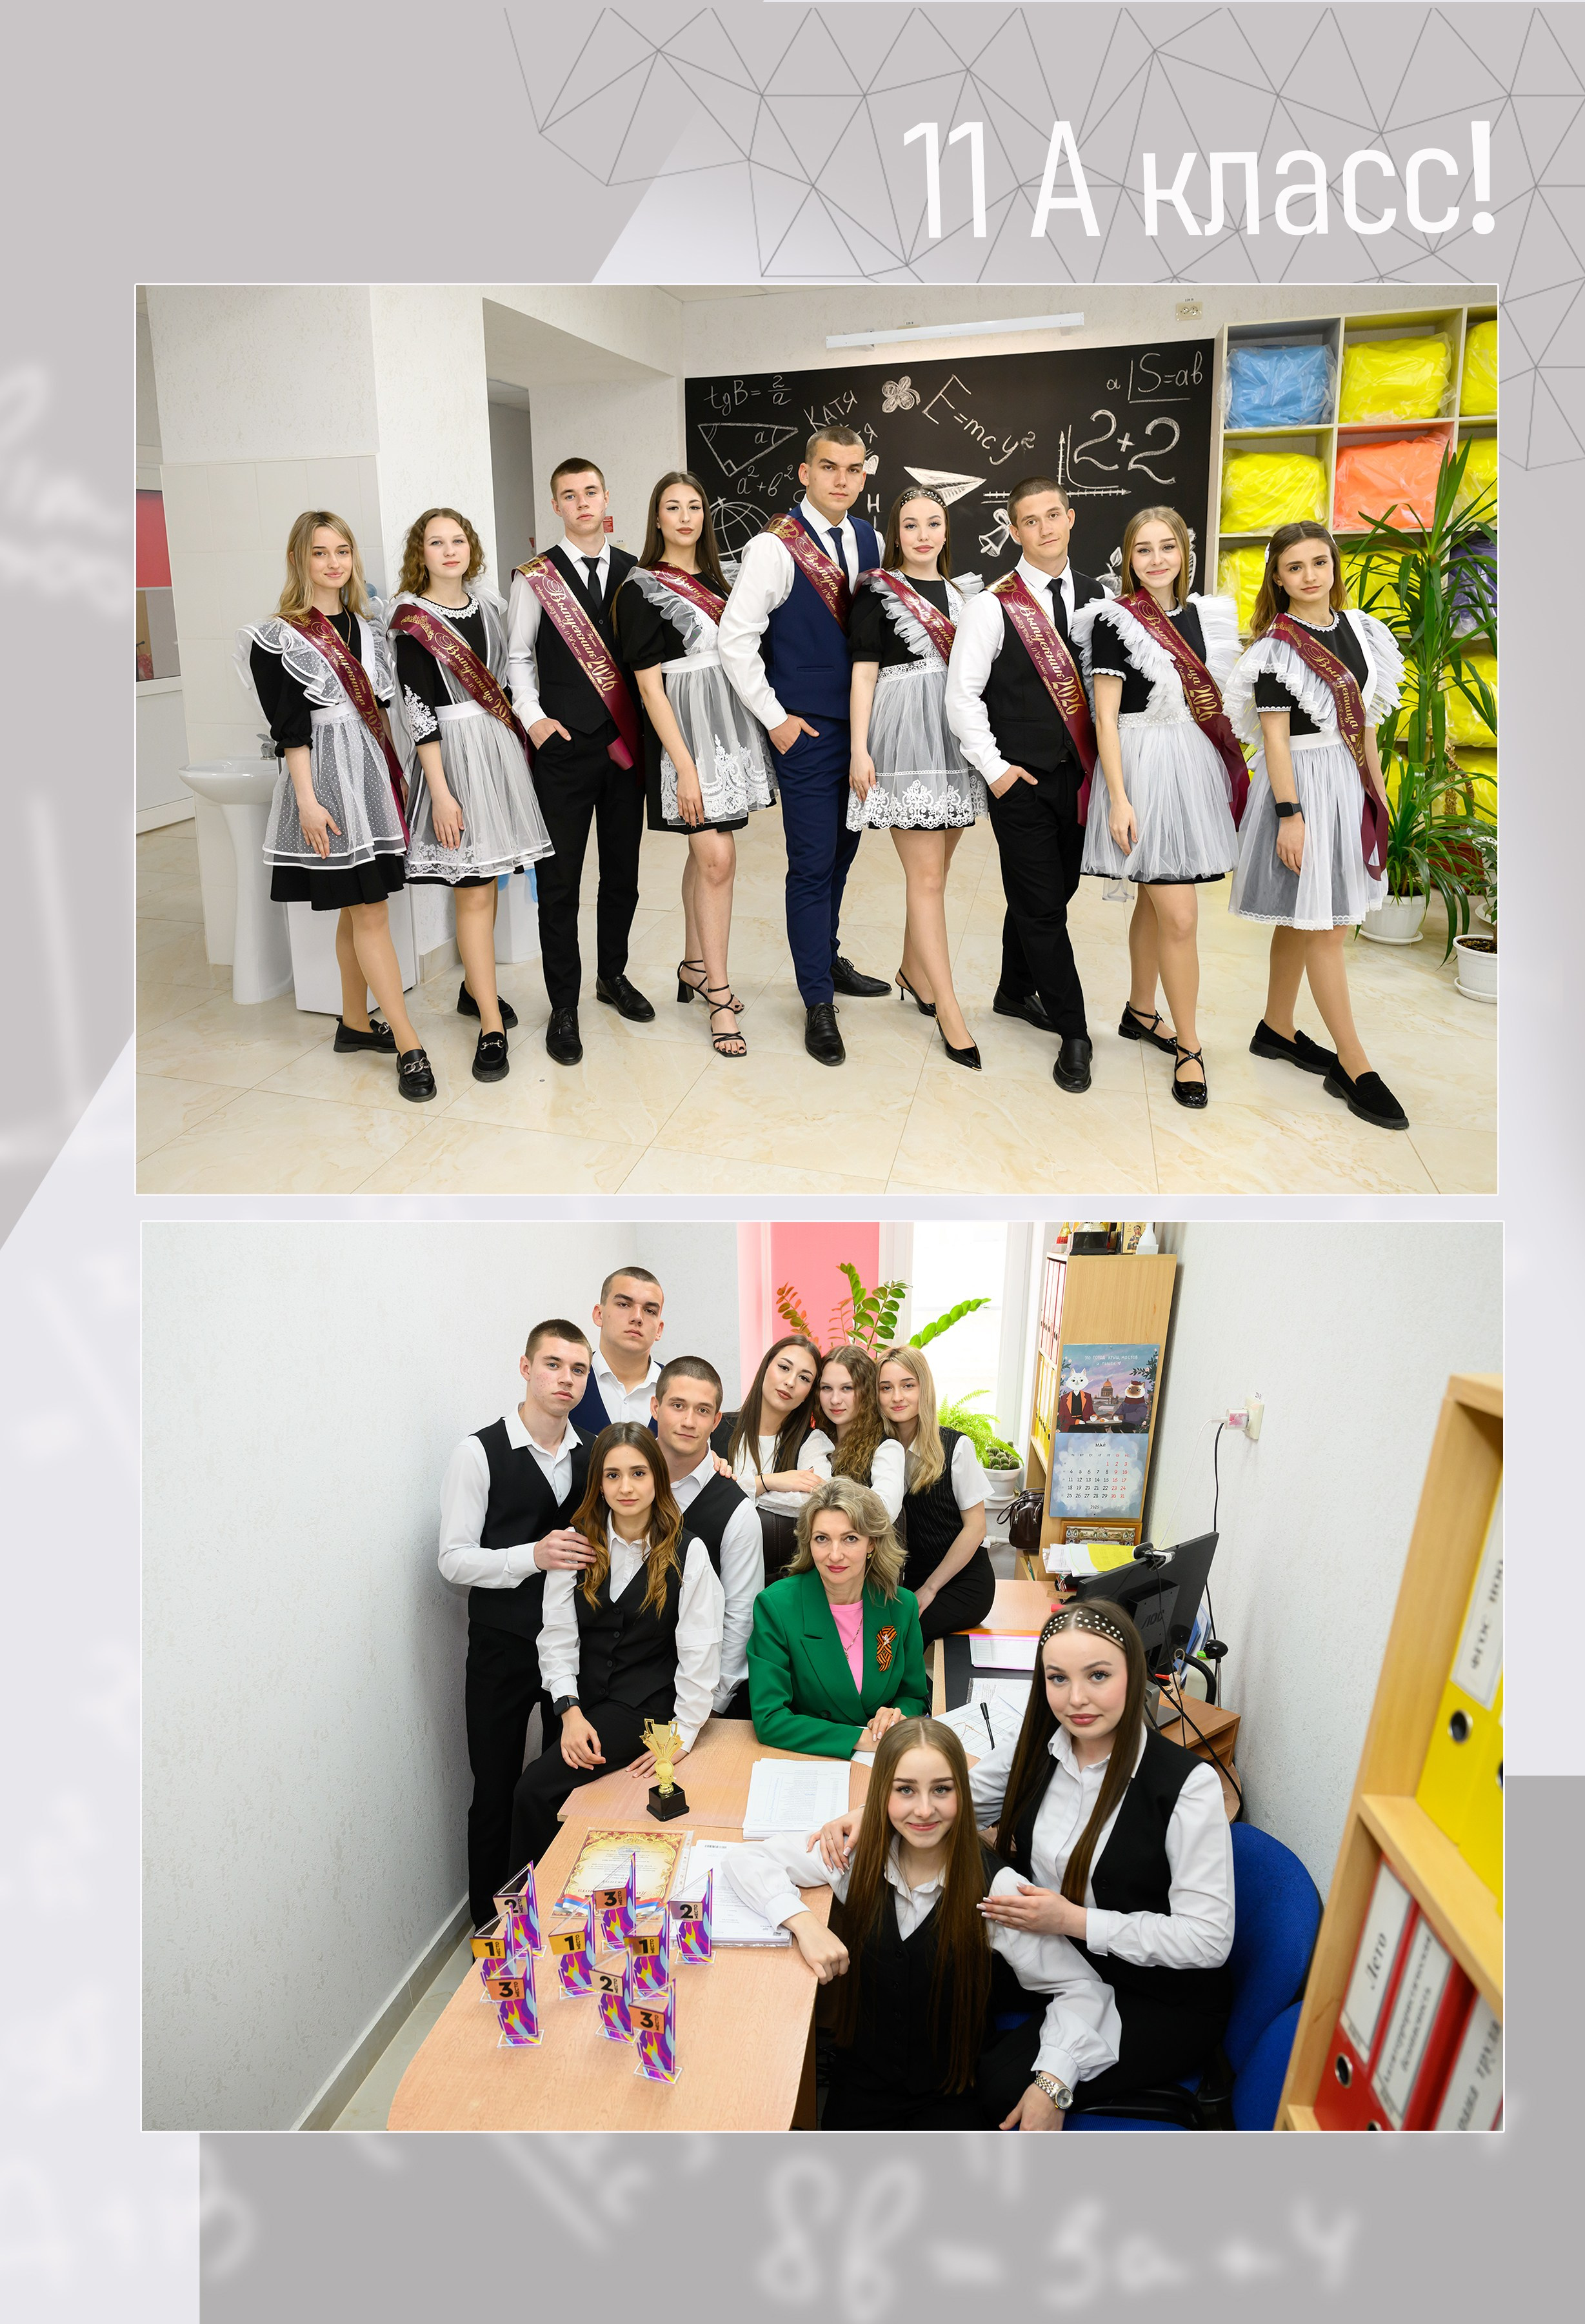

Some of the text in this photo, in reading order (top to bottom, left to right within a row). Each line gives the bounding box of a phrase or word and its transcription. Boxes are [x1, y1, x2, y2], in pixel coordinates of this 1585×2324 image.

[803, 390, 858, 432] КАТЯ
[662, 569, 723, 615] Выпускни
[542, 575, 597, 659] Выпускник
[586, 656, 619, 692] 2026
[311, 621, 365, 706] Выпускница
[1012, 590, 1083, 715] Выпускник 2026
[1138, 600, 1201, 686] Выпускница
[1190, 685, 1223, 721] 2026
[435, 632, 493, 703] Выпускница
[1303, 643, 1358, 730] Выпускница
[504, 1899, 518, 1914] 2
[604, 1891, 617, 1907] 3
[680, 1904, 693, 1919] 2
[484, 1942, 494, 1957] 1
[564, 1936, 575, 1950] 1
[639, 1940, 649, 1955] 1
[1371, 1933, 1388, 1990] Лето
[499, 1982, 513, 1997] 3
[600, 1976, 613, 1992] 2
[640, 2011, 654, 2028] 3
